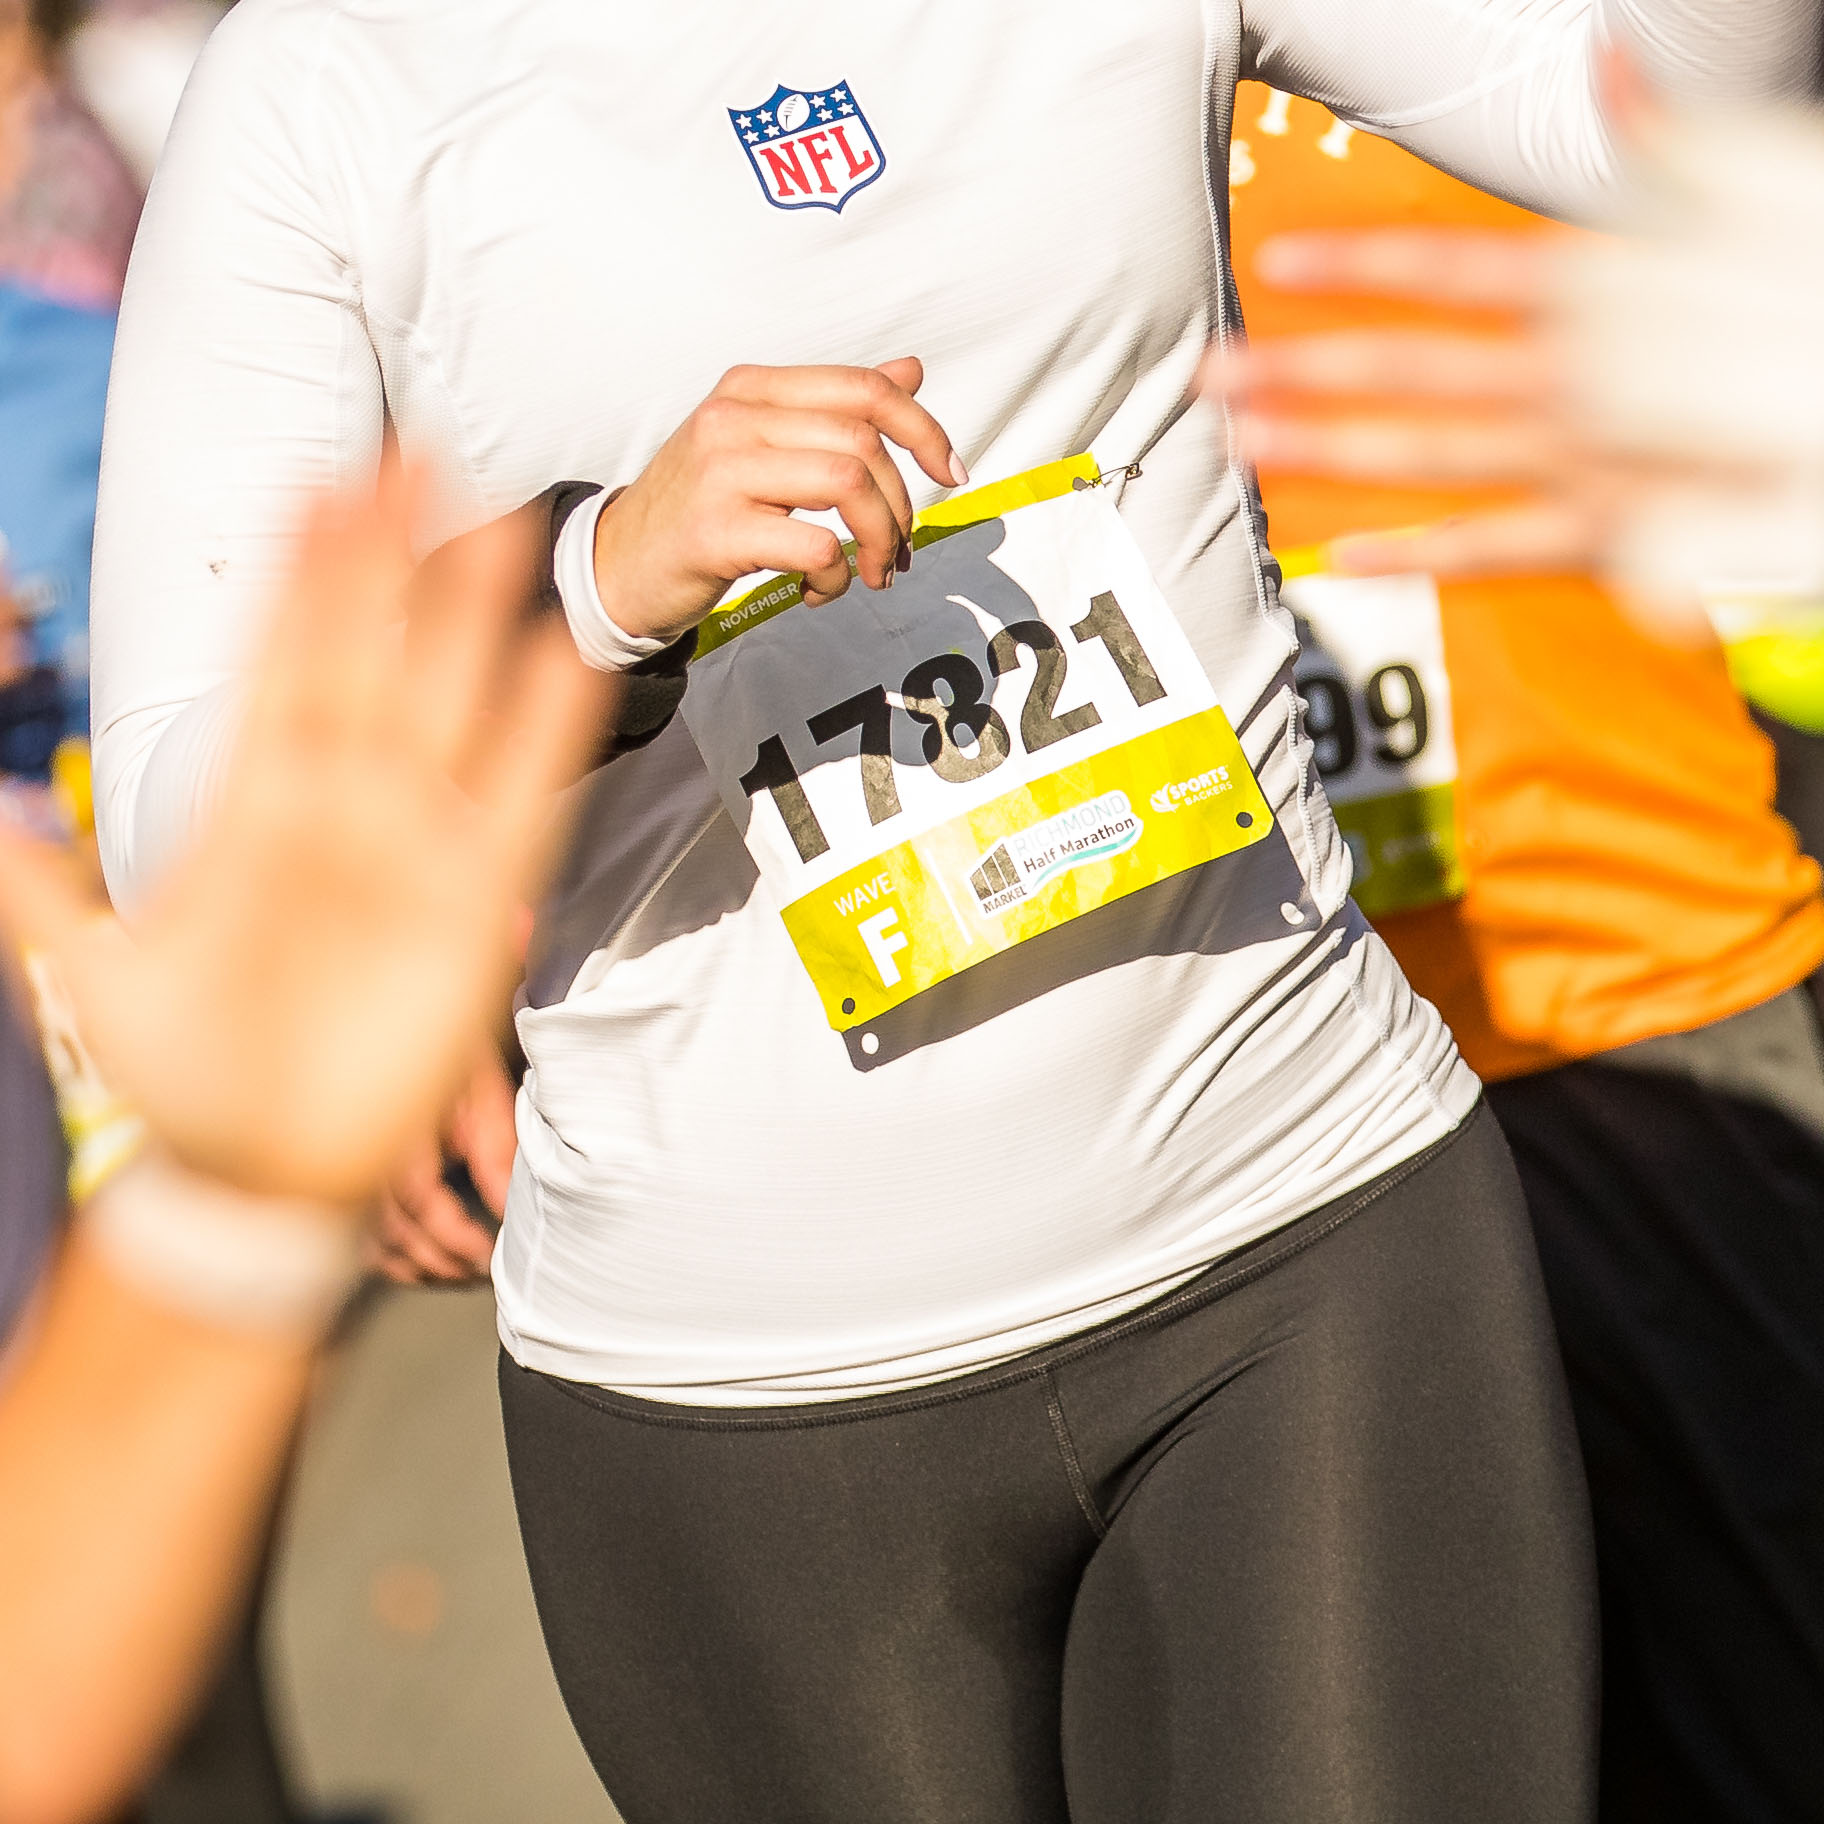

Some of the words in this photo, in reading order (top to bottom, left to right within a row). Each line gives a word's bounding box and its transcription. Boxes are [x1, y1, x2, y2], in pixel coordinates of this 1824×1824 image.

[759, 125, 875, 197] NFL
[719, 581, 799, 633] NOVEMBER
[738, 589, 1168, 864] 17821
[1169, 766, 1230, 801] SPORTS
[1183, 781, 1233, 807] BACKERS
[1014, 795, 1126, 855] RICHMOND
[1023, 847, 1056, 873] Half
[1059, 818, 1135, 856] Marathon
[833, 871, 896, 917] WAVE
[983, 886, 1027, 914] MARKEL
[857, 906, 909, 989] F
